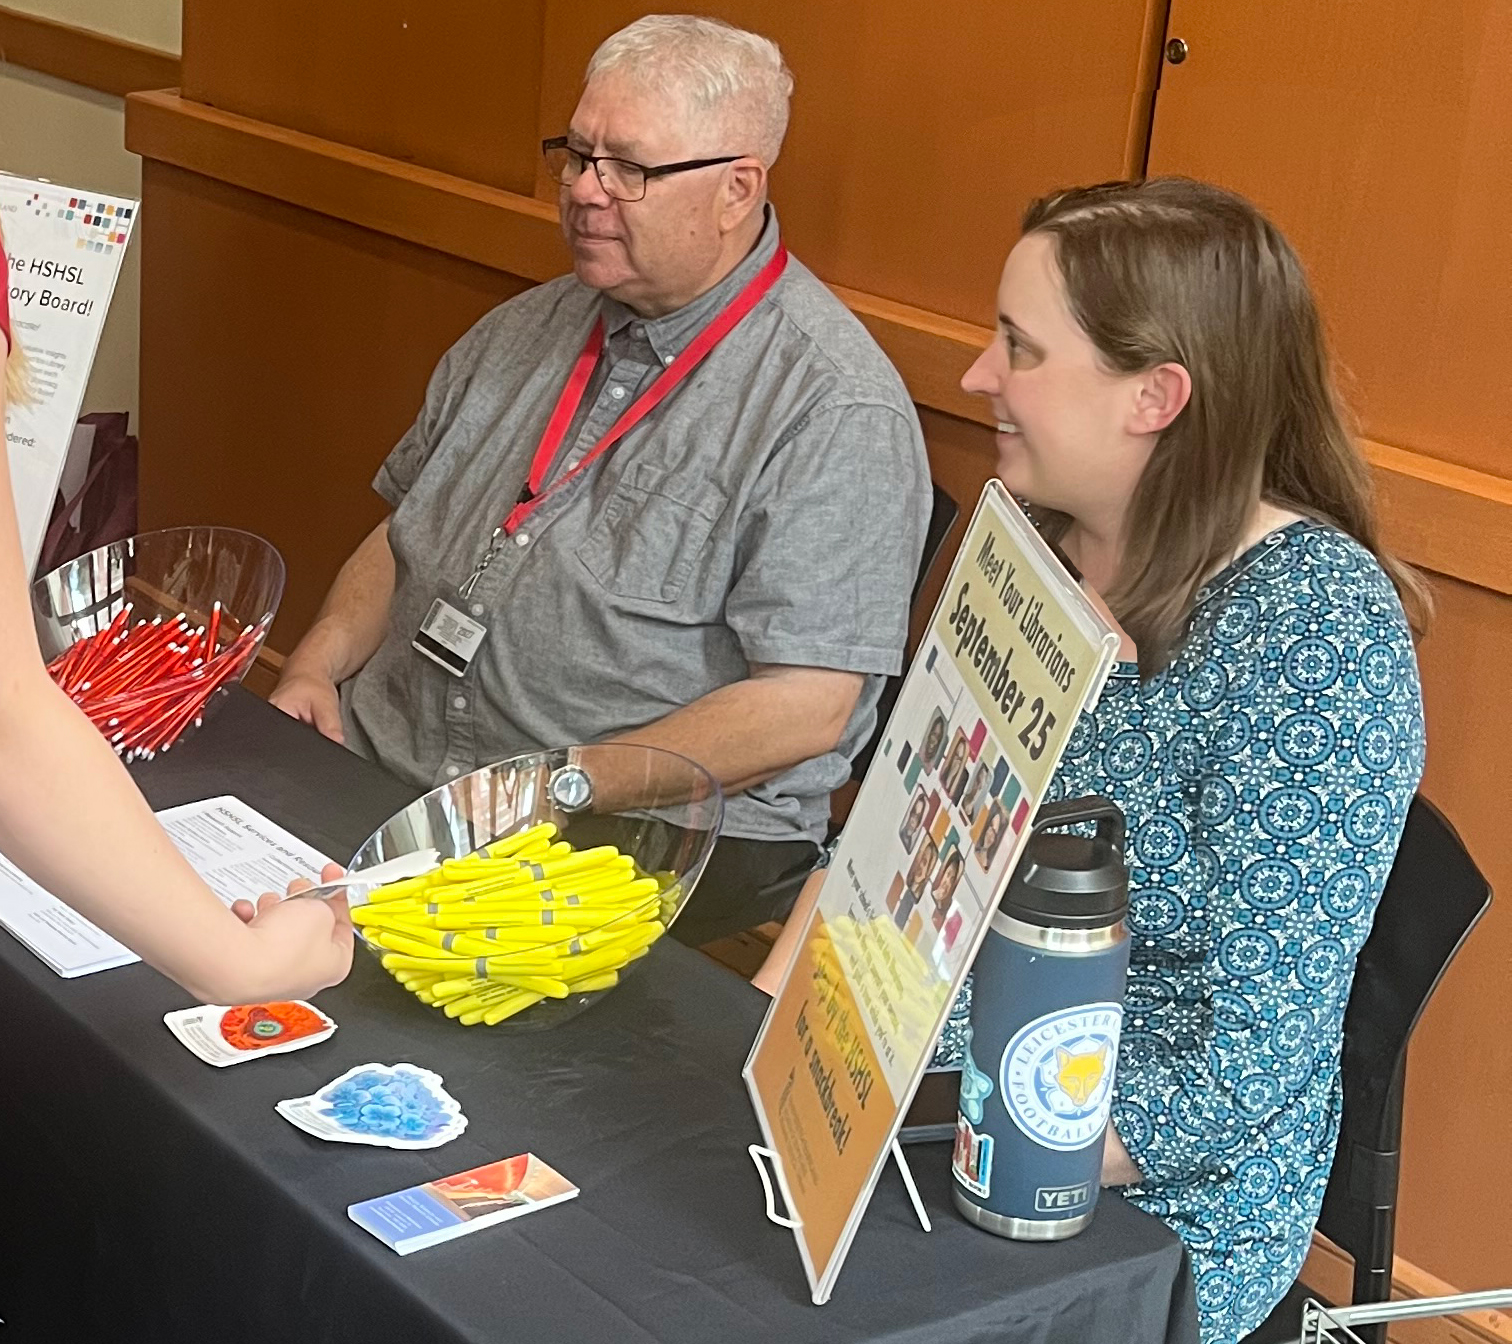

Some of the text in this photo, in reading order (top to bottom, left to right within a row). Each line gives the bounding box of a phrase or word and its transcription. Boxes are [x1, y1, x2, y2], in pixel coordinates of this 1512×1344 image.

[7, 253, 85, 286] he HSHSL
[8, 286, 94, 317] ory Board!
[6, 433, 36, 447] dered:
[975, 531, 1077, 694] Meet Your Librarians
[949, 582, 1058, 761] September 25
[242, 824, 278, 849] Services
[1015, 1013, 1113, 1065] LEICESTER
[844, 1035, 874, 1110] HSHSL
[1041, 1187, 1088, 1207] YETI
